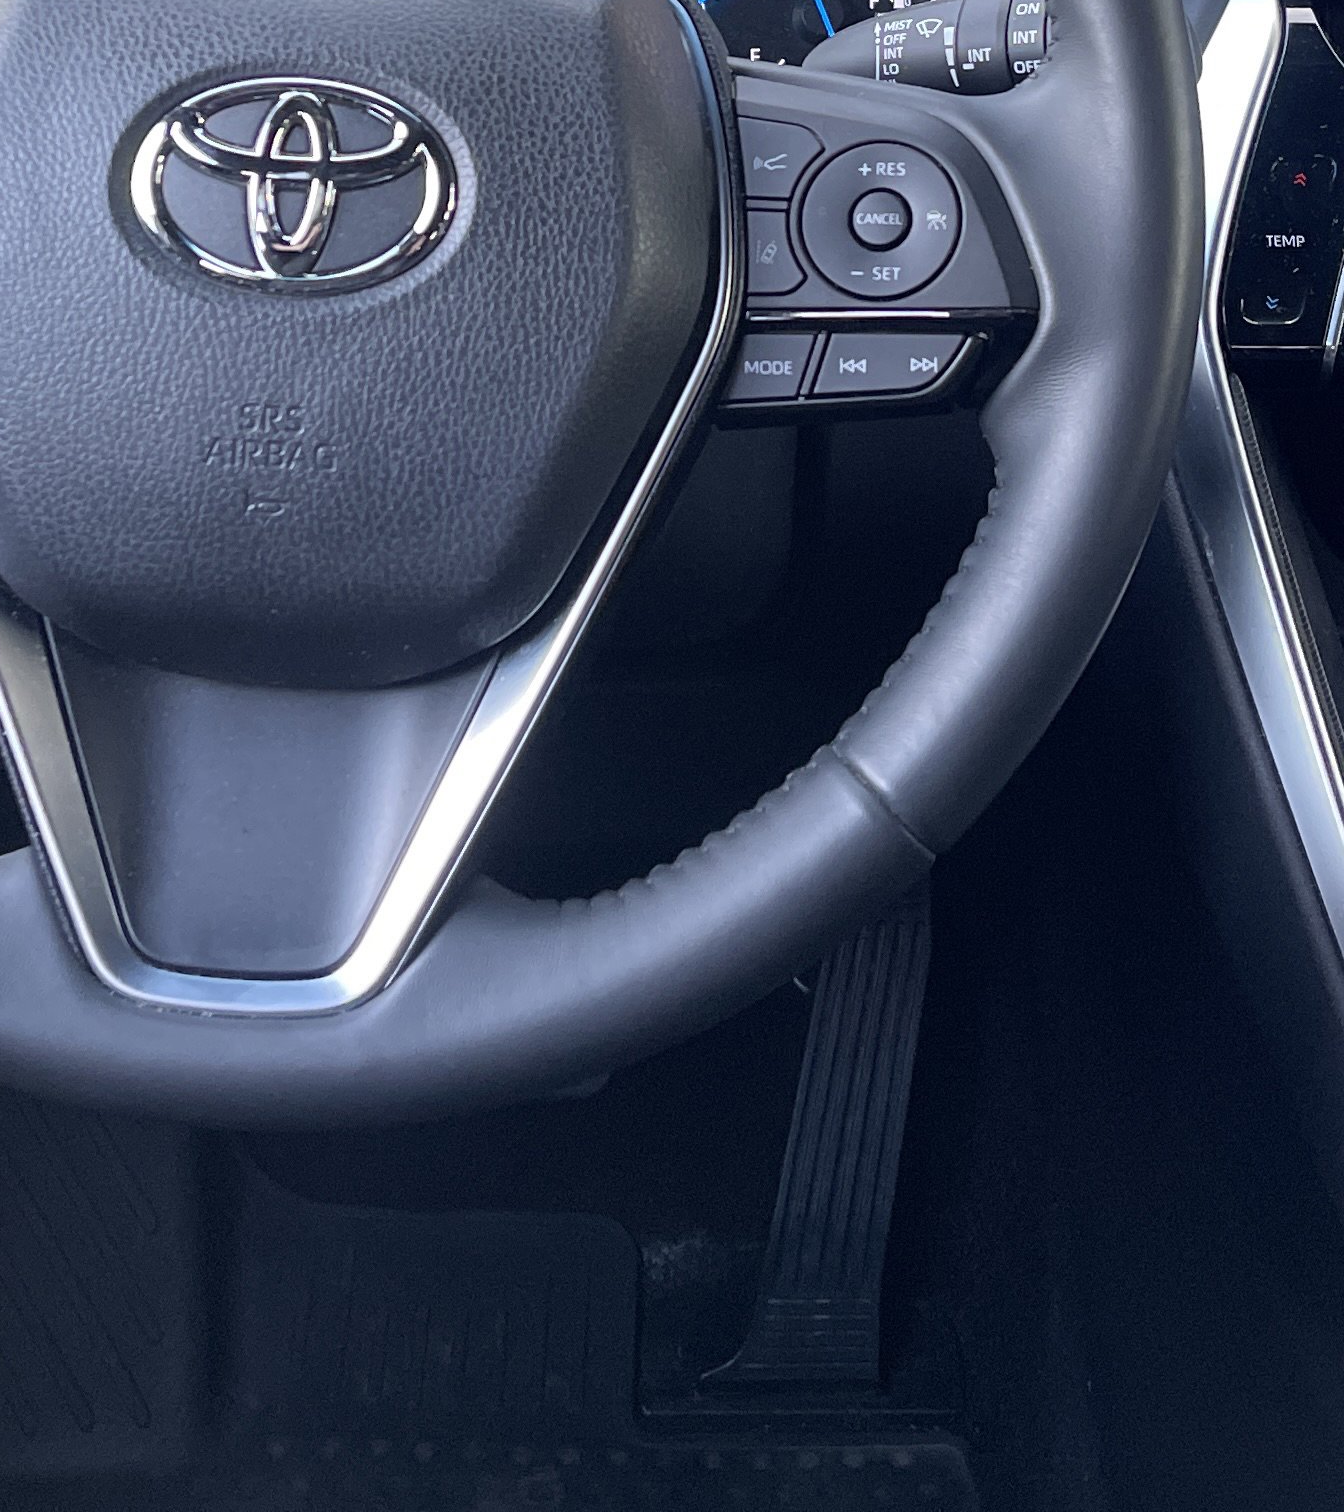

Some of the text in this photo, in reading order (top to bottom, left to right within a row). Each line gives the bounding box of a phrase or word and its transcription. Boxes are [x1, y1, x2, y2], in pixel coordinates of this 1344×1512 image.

[1016, 2, 1040, 15] ON
[884, 19, 913, 32] MIST
[883, 34, 907, 45] OFF
[1013, 30, 1037, 44] INT
[883, 46, 904, 59] INT
[967, 47, 991, 62] INT
[883, 63, 899, 75] LO
[876, 162, 906, 176] RES
[856, 212, 903, 226] CANCEL
[1266, 235, 1305, 247] TEMP
[873, 267, 901, 280] SET
[745, 361, 793, 375] MODE
[240, 403, 305, 434] SRS
[204, 437, 338, 473] AIRBAG
